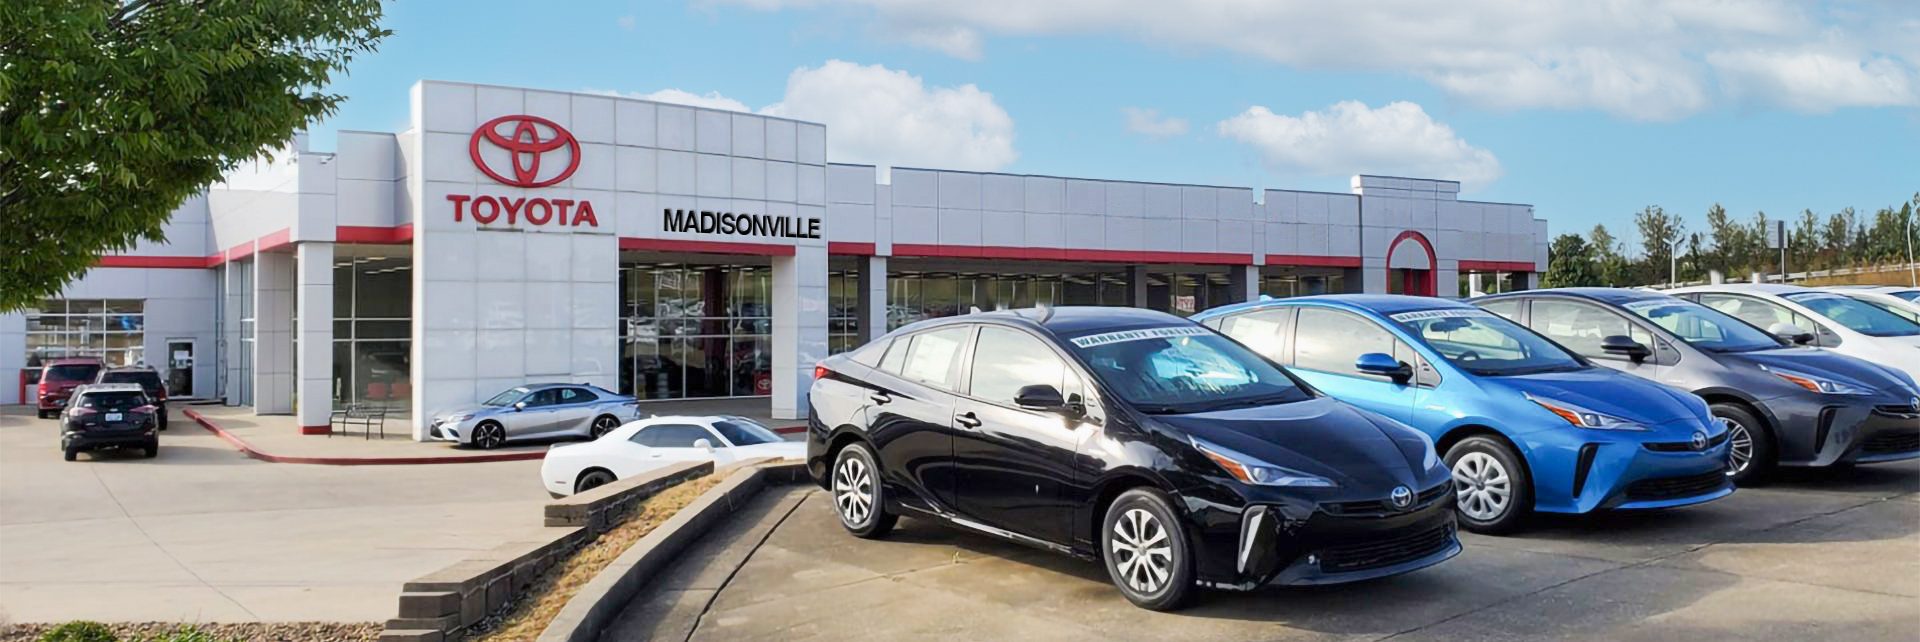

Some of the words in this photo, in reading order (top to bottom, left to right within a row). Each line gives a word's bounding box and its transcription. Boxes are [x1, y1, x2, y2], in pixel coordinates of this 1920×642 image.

[446, 194, 598, 227] TOYOTA
[663, 208, 821, 239] MADISONVILLE
[1076, 330, 1148, 346] WARRANTY
[1152, 327, 1204, 337] FOREVER
